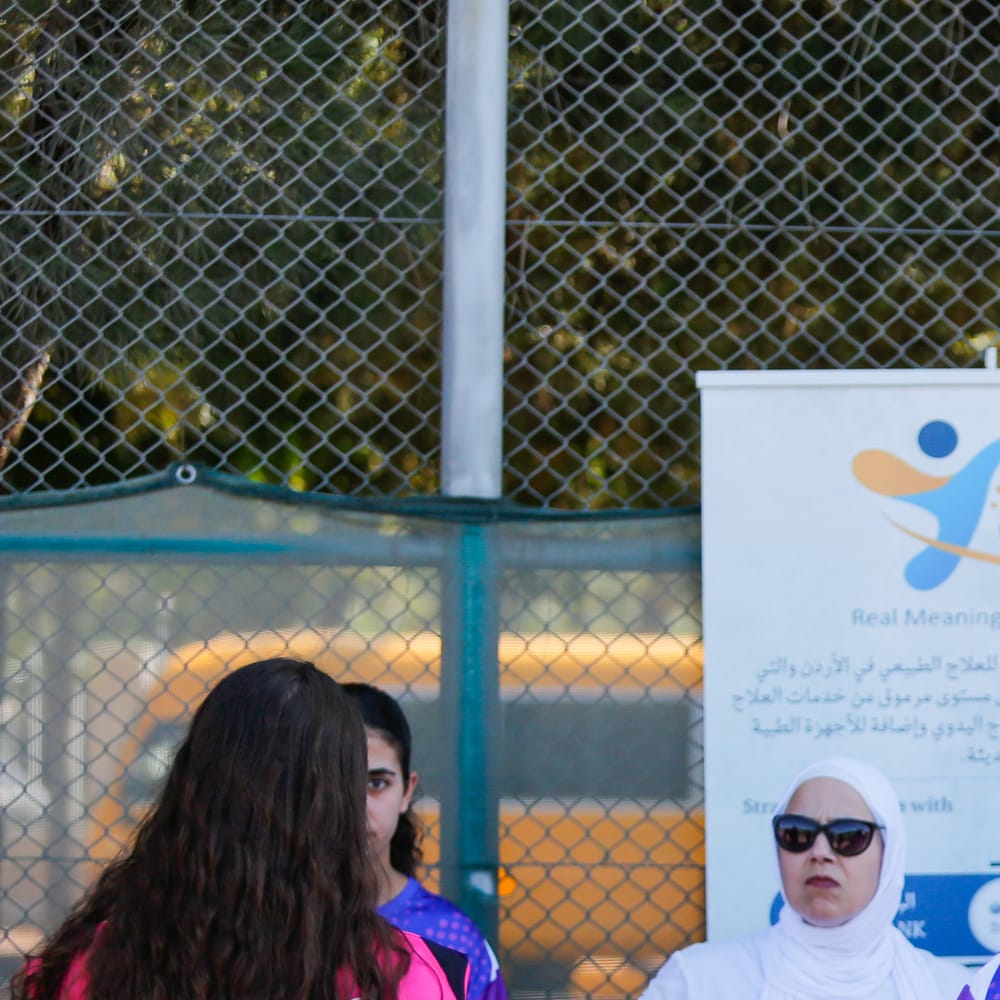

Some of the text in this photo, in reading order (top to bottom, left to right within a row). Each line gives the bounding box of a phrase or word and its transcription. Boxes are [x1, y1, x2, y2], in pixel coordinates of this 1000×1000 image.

[851, 608, 897, 626] Real
[757, 655, 797, 683] والتي
[801, 652, 849, 678] الأردن
[855, 655, 873, 683] في
[880, 655, 942, 683] الطبيعي
[945, 655, 998, 681] للعلاج
[732, 686, 783, 712] العلاج
[786, 687, 845, 704] خدمات
[852, 692, 873, 708] من
[752, 716, 801, 739] الطبية
[911, 798, 953, 814] with
